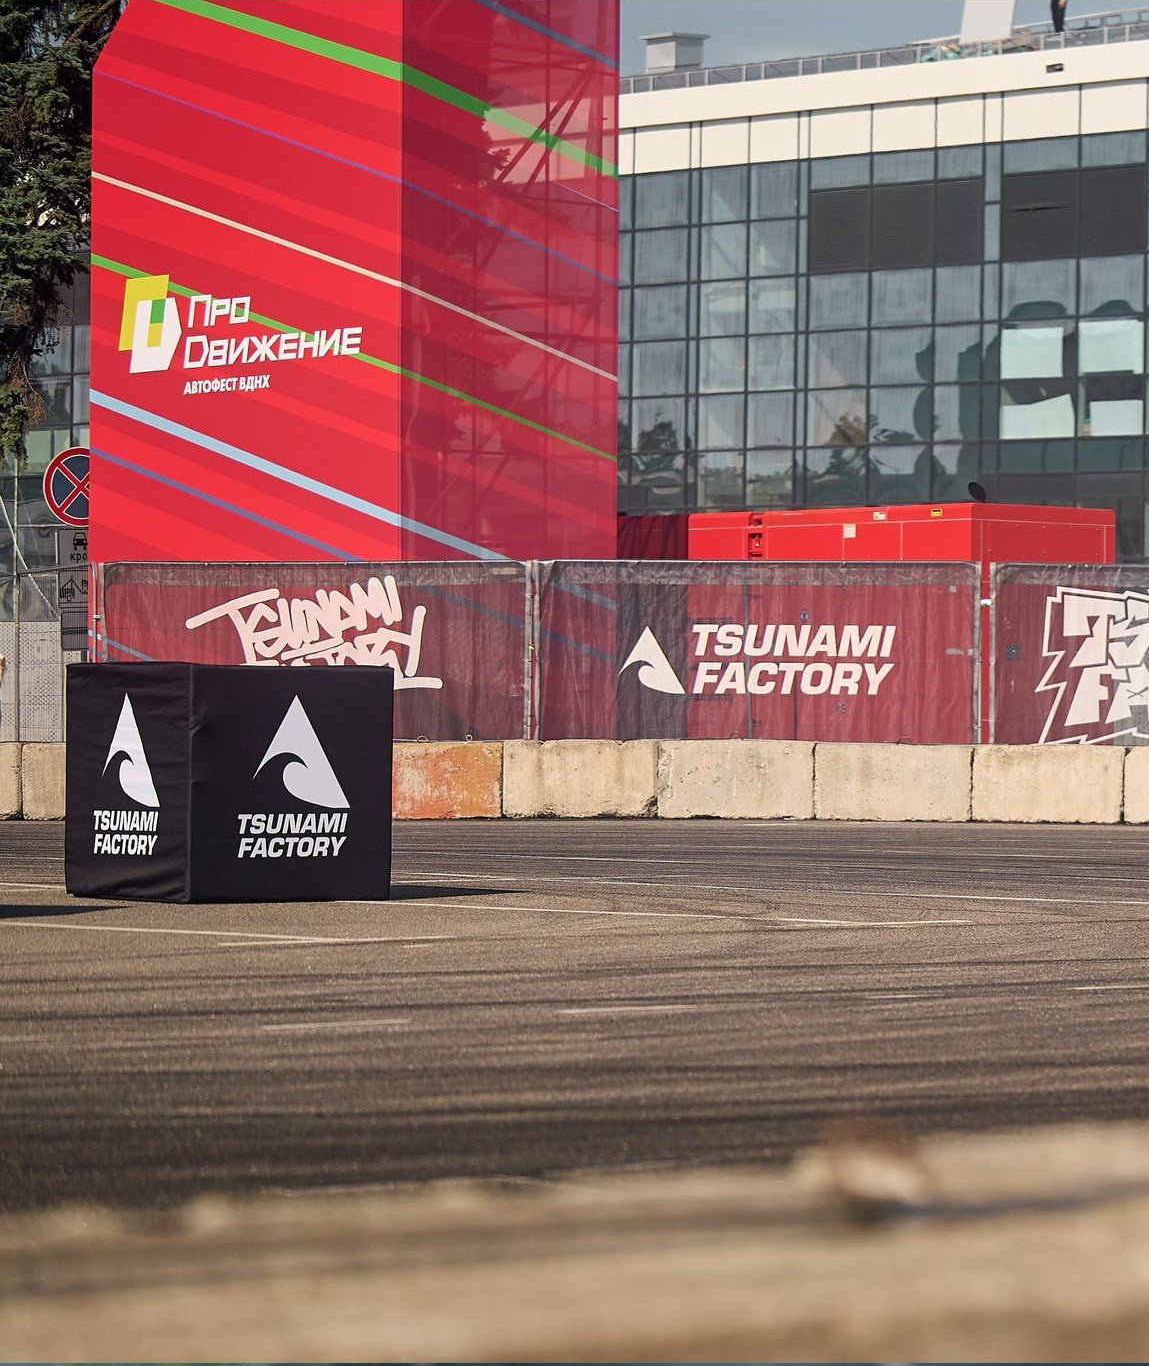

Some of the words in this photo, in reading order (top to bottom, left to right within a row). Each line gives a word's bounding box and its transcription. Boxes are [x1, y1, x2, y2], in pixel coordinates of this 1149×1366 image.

[183, 376, 238, 395] АВТОФЕСТ
[238, 374, 271, 392] ВДНХ
[185, 575, 403, 663] TSUNAMI
[692, 624, 896, 657] TSUNAMI
[692, 662, 895, 695] FACTORY
[93, 810, 159, 832] TSUNAMI
[237, 813, 348, 835] TSUNAMI
[93, 834, 158, 856] FACTORY
[237, 836, 347, 858] FACTORY
